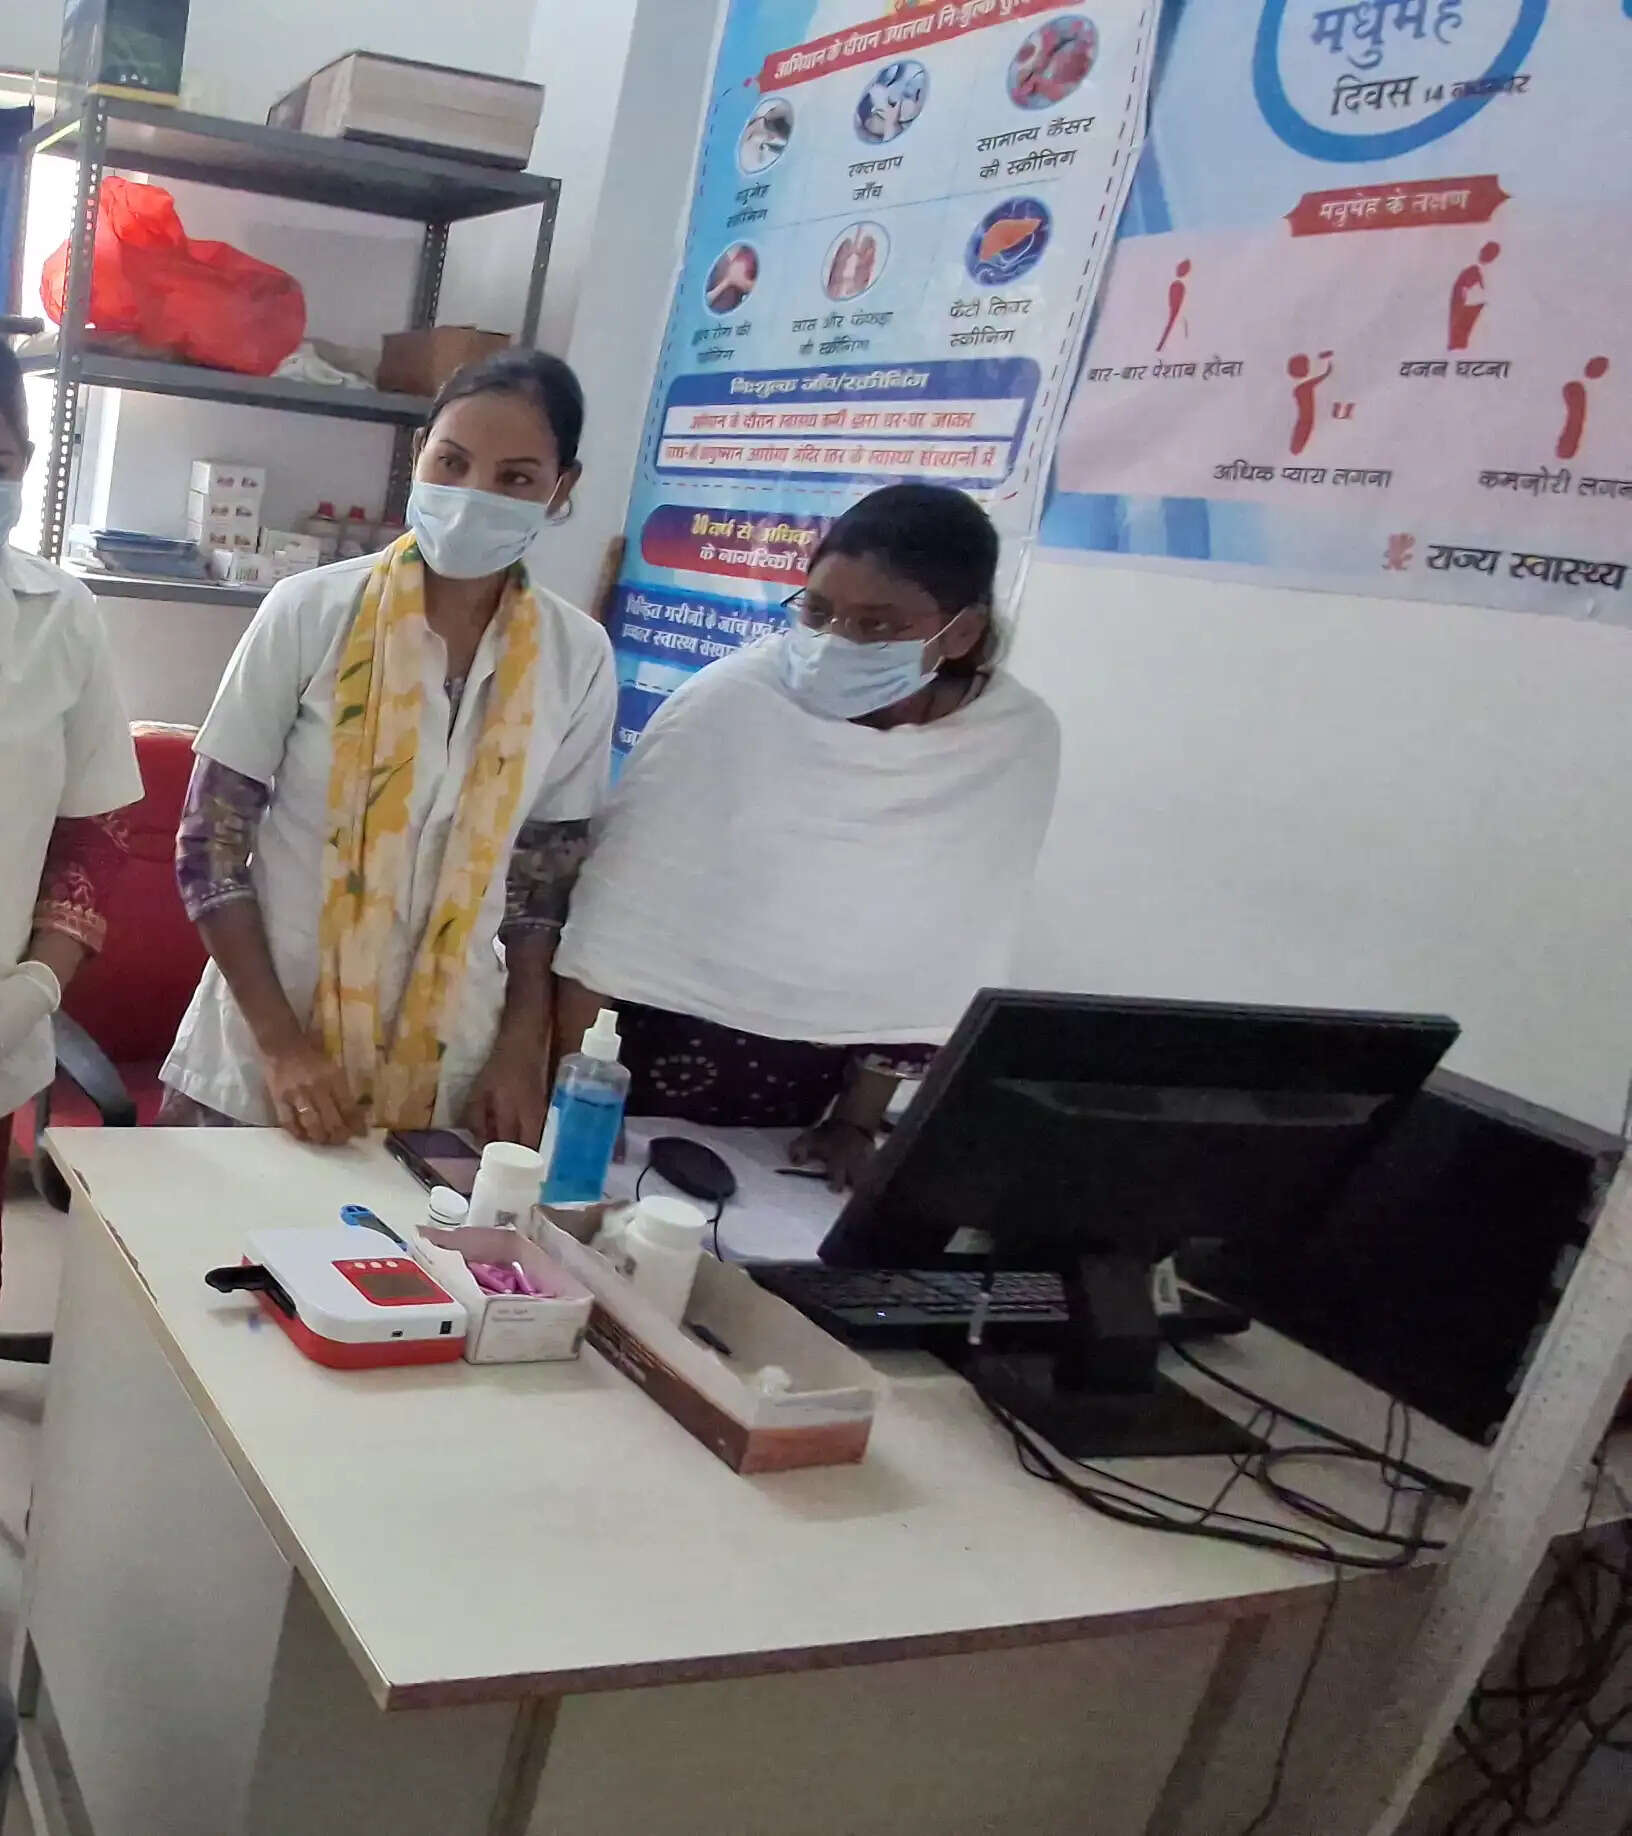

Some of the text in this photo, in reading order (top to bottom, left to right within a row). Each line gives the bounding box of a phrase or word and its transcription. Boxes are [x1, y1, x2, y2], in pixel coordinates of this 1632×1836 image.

[1310, 0, 1464, 69] मधुमह
[1330, 73, 1420, 116] दिवस
[976, 126, 1042, 153] सामान्य
[979, 158, 1001, 179] की
[1455, 360, 1512, 379] घटना
[1213, 458, 1275, 482] अधिक
[1332, 467, 1394, 489] लगना
[1576, 476, 1632, 500] लगन
[737, 521, 754, 540] से
[699, 542, 718, 562] के
[718, 547, 796, 572] नागरिकों
[1425, 544, 1629, 591] राज्य स्वास्थ्य
